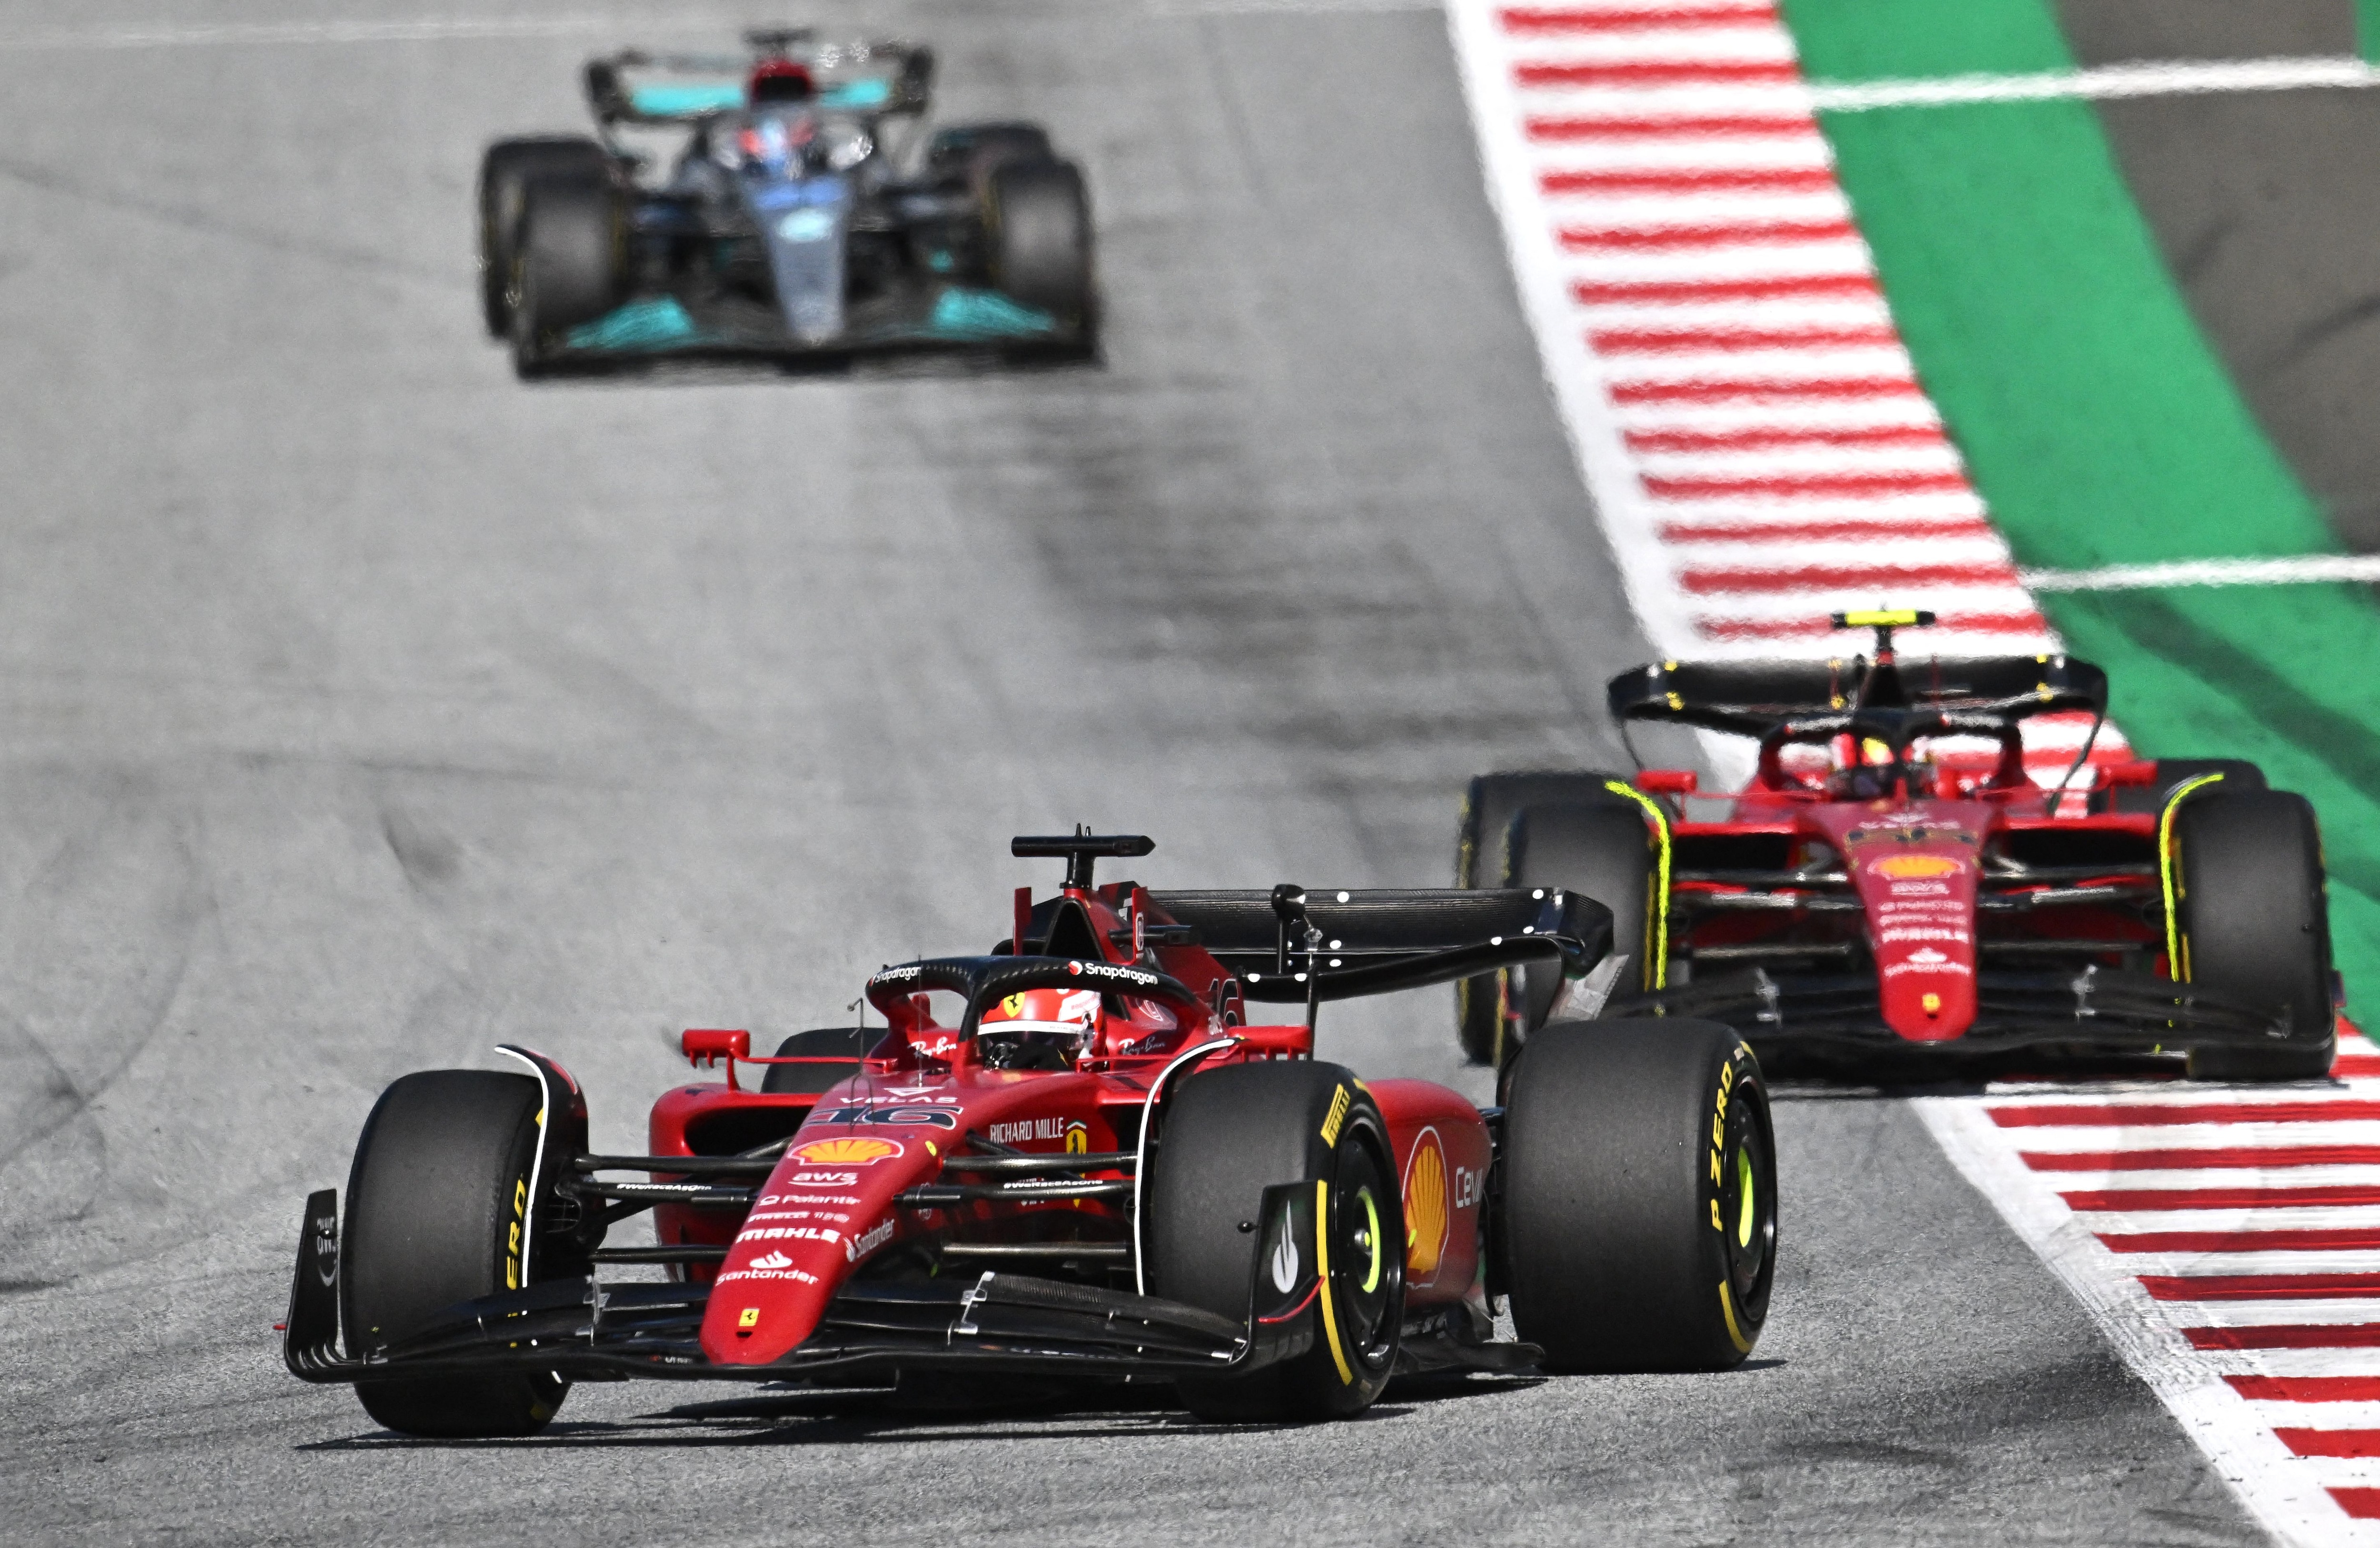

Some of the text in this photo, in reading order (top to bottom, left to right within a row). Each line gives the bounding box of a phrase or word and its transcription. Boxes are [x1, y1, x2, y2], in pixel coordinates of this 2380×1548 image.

[875, 966, 922, 983] Snapdragon
[1085, 963, 1158, 985] Snapdragon
[802, 1105, 964, 1130] 16
[990, 1117, 1064, 1144] RICHARD MILLE
[1710, 1060, 1733, 1232] P ZERO
[792, 1172, 858, 1182] aws
[506, 1179, 526, 1290] ERO
[736, 1227, 841, 1244] MAHLE
